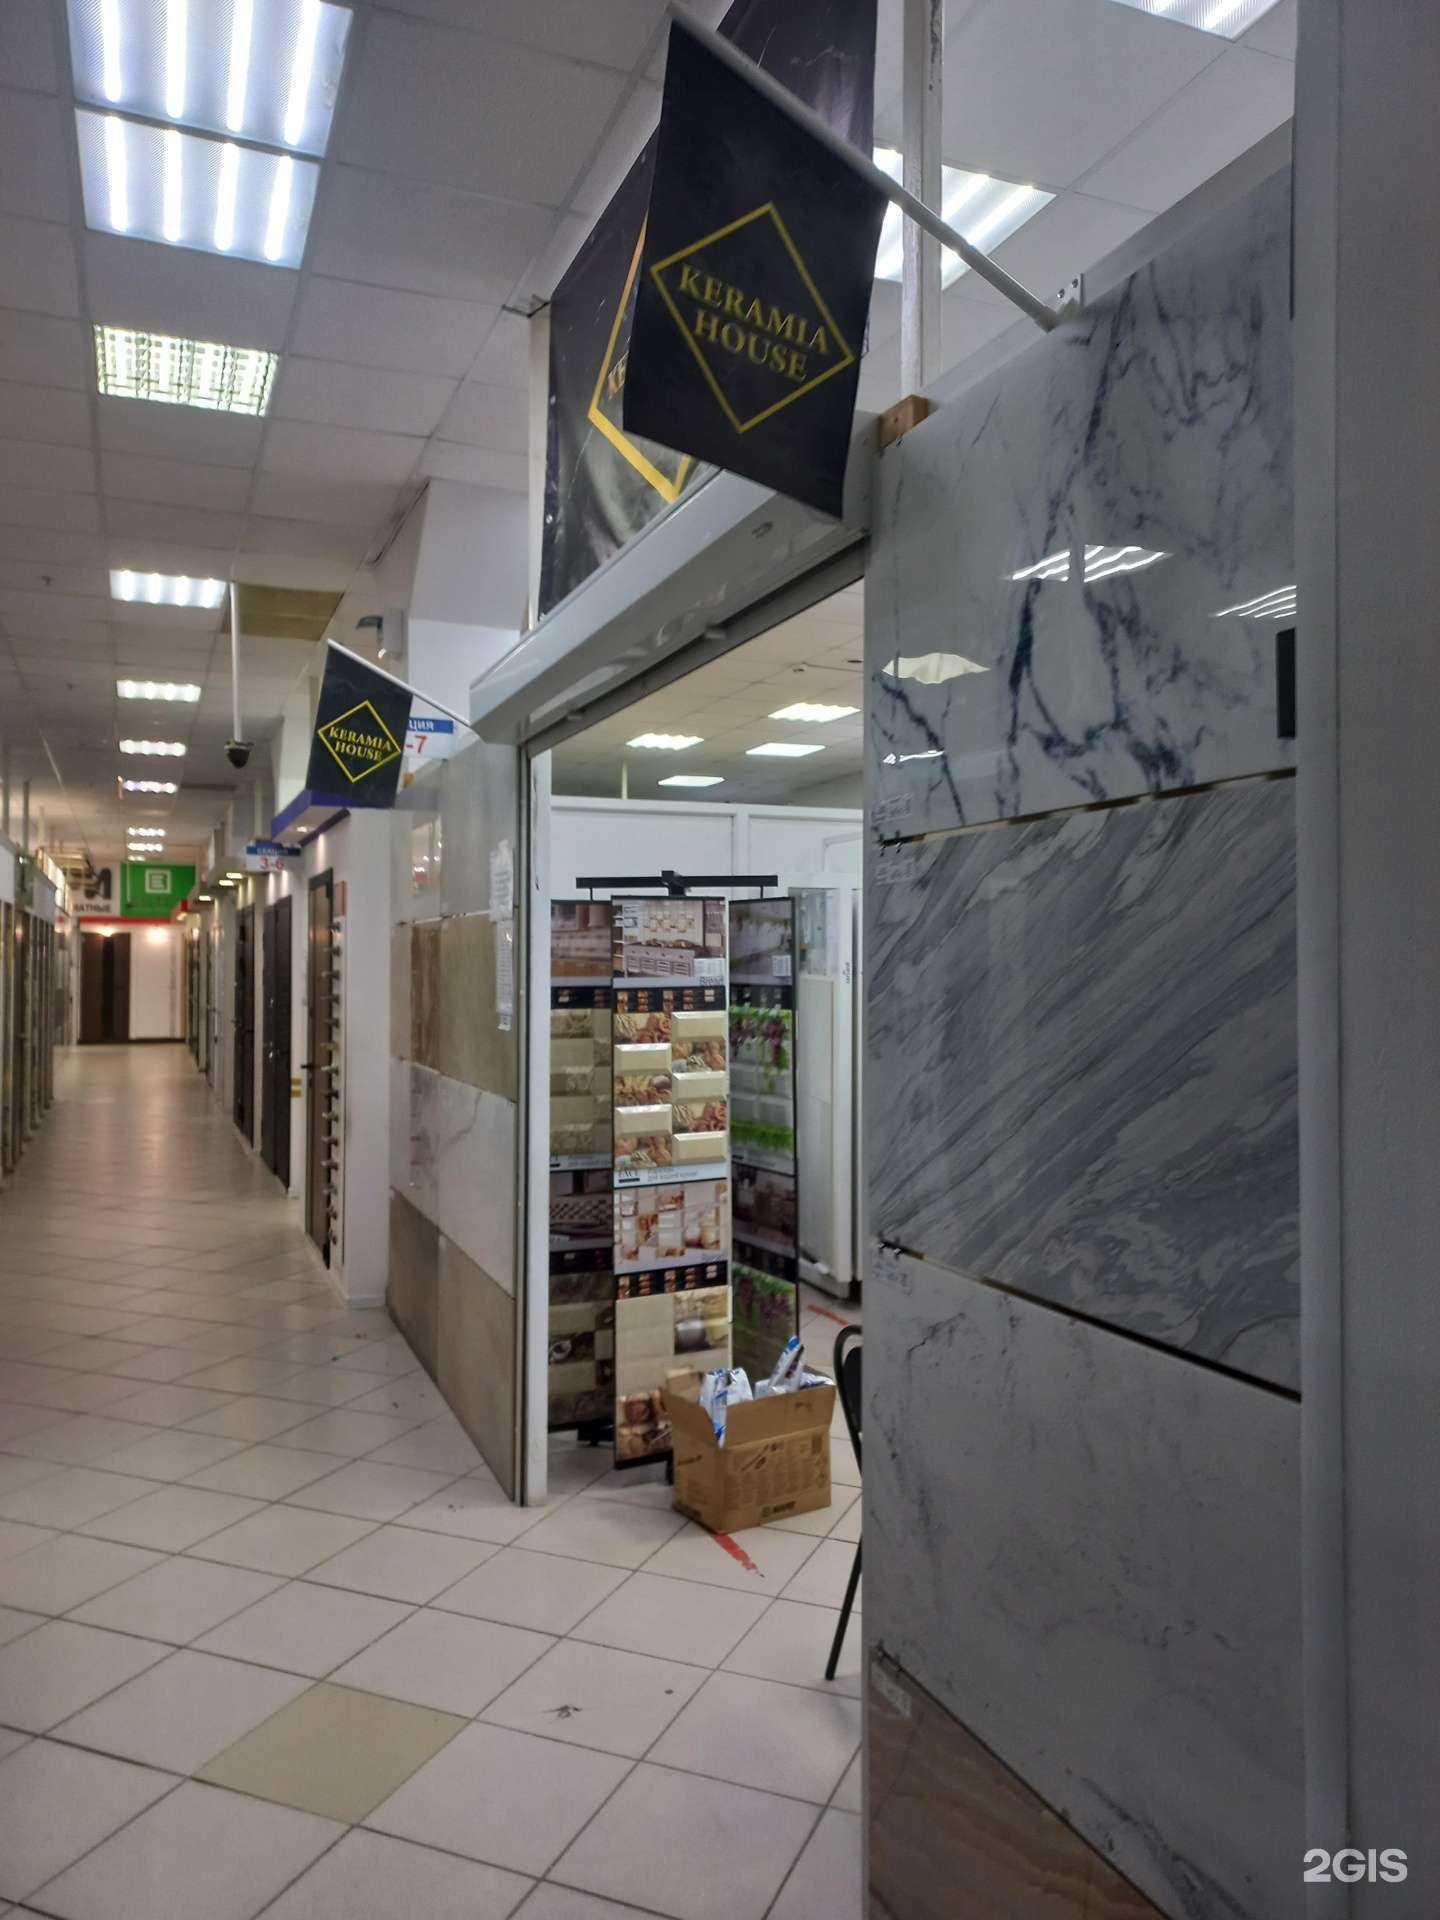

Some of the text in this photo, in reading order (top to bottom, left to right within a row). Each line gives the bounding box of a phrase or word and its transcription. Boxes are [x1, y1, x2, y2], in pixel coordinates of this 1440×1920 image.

[677, 264, 830, 354] KERAMIA
[694, 311, 809, 382] HOUSE
[329, 726, 391, 752] KERAMIA
[335, 740, 383, 762] HOUSE
